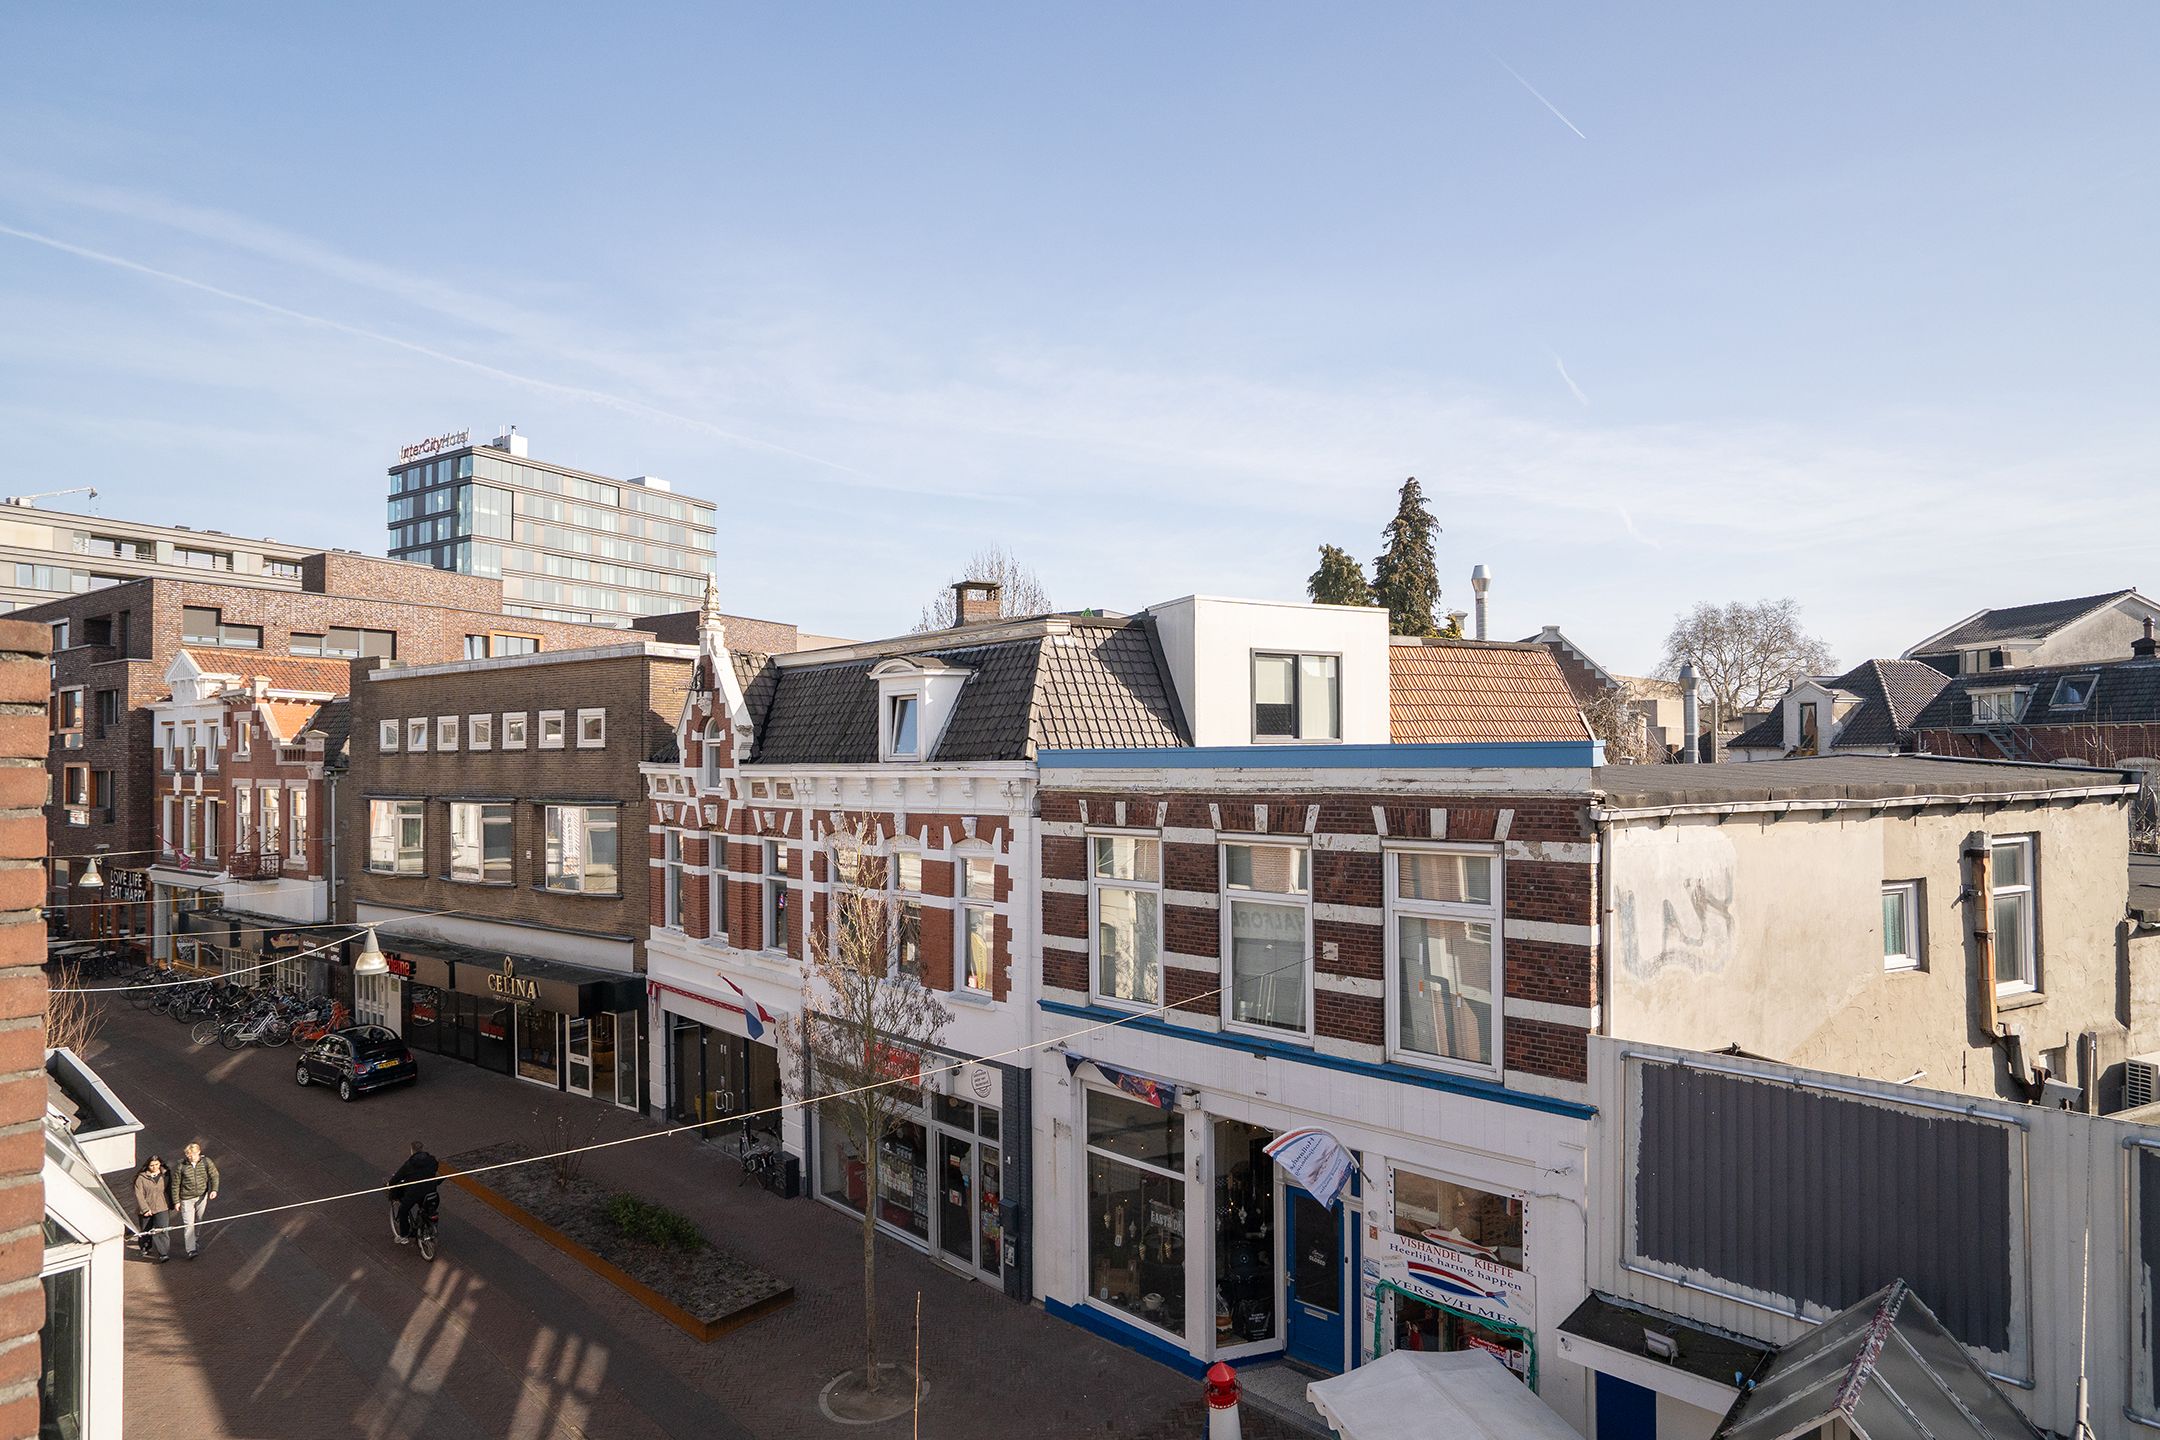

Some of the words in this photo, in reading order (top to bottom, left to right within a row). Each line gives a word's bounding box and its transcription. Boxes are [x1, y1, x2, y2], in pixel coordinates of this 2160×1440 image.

[400, 427, 469, 459] InterCityHotel
[111, 870, 127, 885] LOVE
[129, 872, 142, 887] LIFE
[111, 885, 122, 899] EAT
[124, 888, 146, 902] HAPPY
[488, 973, 538, 999] CELINA
[1390, 1243, 1435, 1263] Heerlijk
[1437, 1258, 1474, 1277] haring
[1477, 1270, 1522, 1291] happen
[1400, 1236, 1463, 1263] VISHANDEL
[1474, 1258, 1514, 1279] KIEFTE
[1391, 1277, 1434, 1298] VERS
[1440, 1294, 1472, 1310] V/H
[1478, 1307, 1518, 1326] MES
